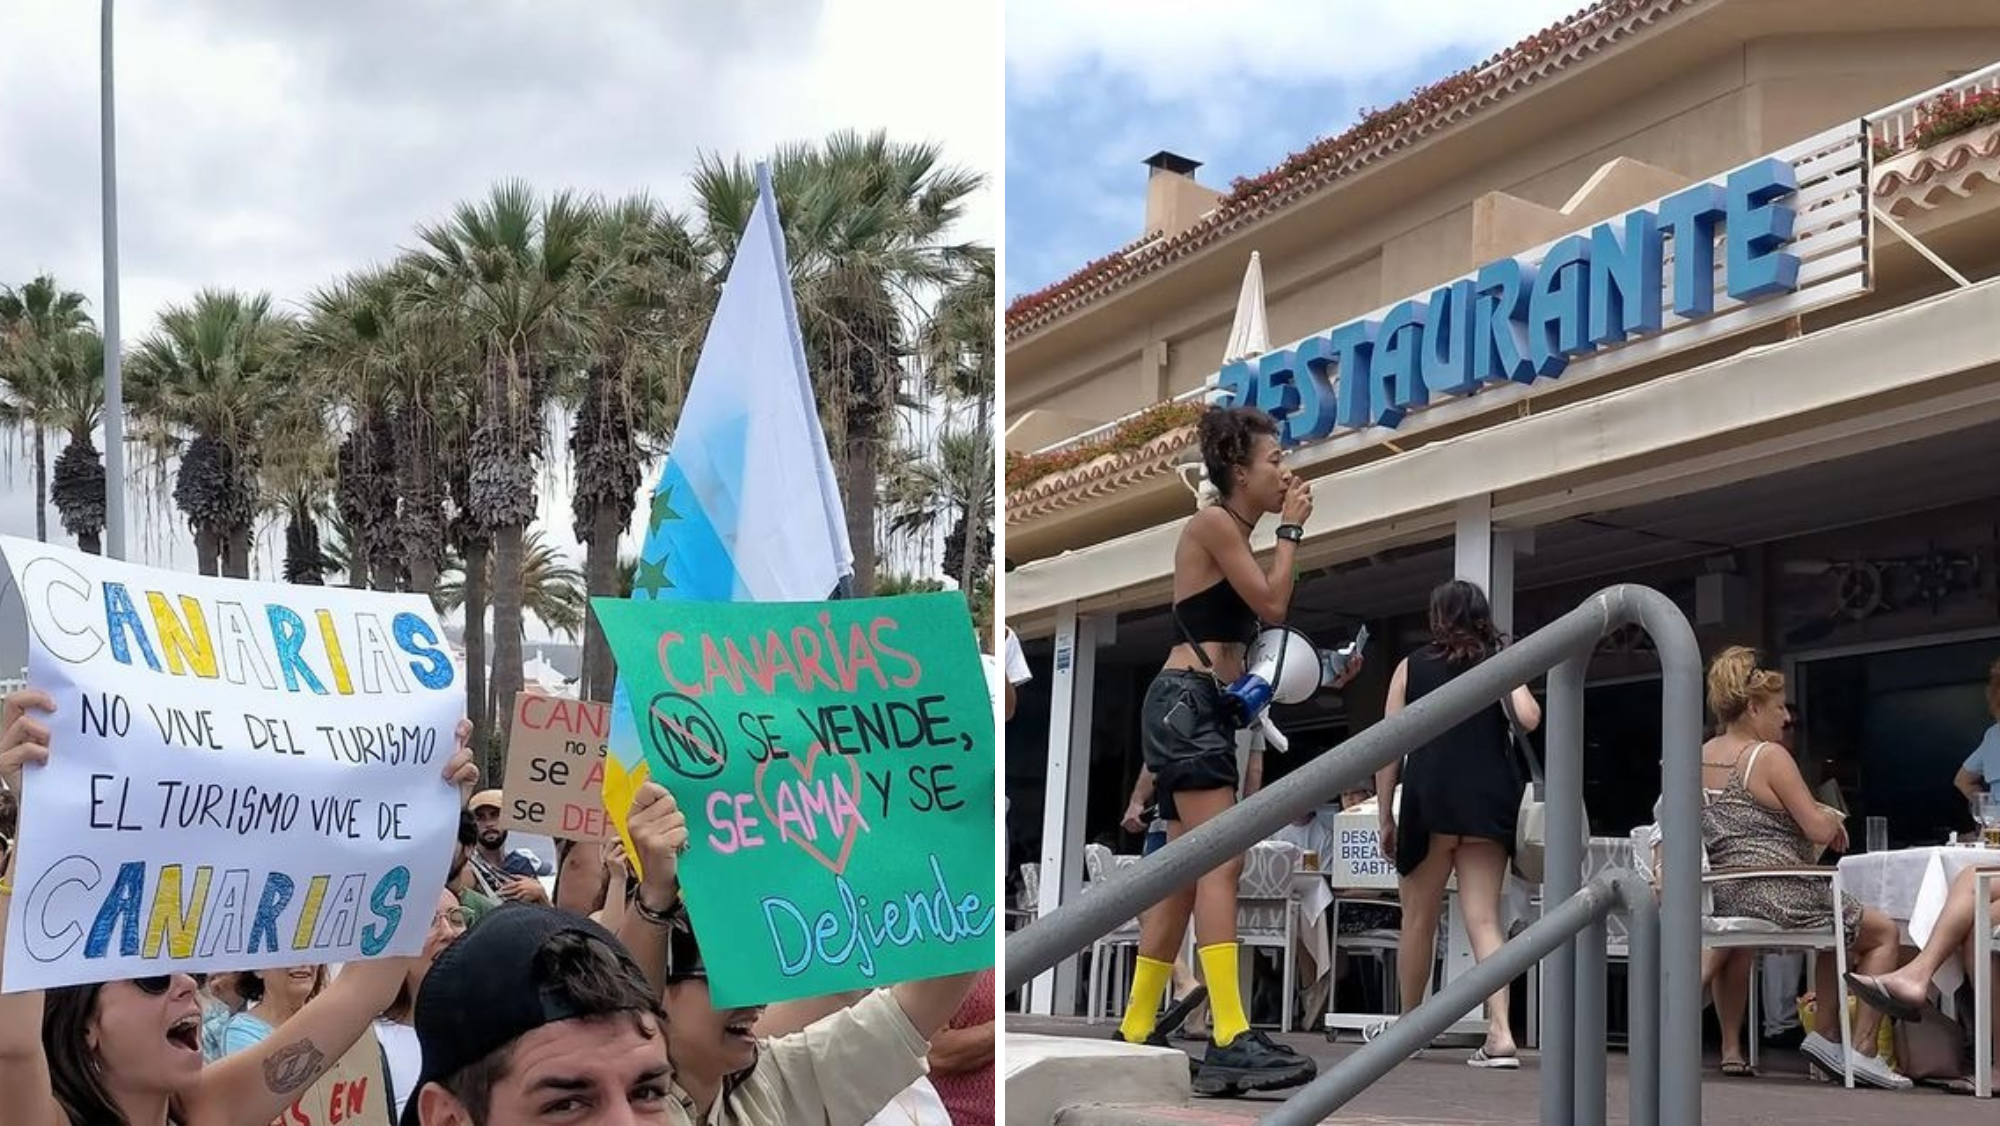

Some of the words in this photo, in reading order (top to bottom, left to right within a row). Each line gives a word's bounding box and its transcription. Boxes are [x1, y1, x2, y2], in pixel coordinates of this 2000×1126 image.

[22, 557, 455, 694] CANARIAS
[81, 693, 130, 738] NO
[149, 702, 222, 750] VIVE
[244, 713, 304, 756] DEL
[317, 724, 436, 766] TURISMO
[520, 696, 611, 738] CAN
[658, 706, 720, 768] NO
[738, 711, 790, 763] SE
[797, 695, 974, 757] VENDE,
[529, 758, 570, 786] se
[565, 740, 587, 756] no
[89, 774, 142, 832] EL
[158, 780, 299, 835] TURISMO
[311, 799, 361, 838] VIVE
[377, 803, 411, 840] DE
[512, 799, 546, 823] se
[706, 790, 765, 854] SE
[776, 772, 871, 843] AMA
[865, 770, 890, 818] Y
[908, 764, 966, 812] SE
[1341, 830, 1381, 844] DESA
[23, 854, 410, 963] CANARIAS
[328, 1076, 368, 1125] EN
